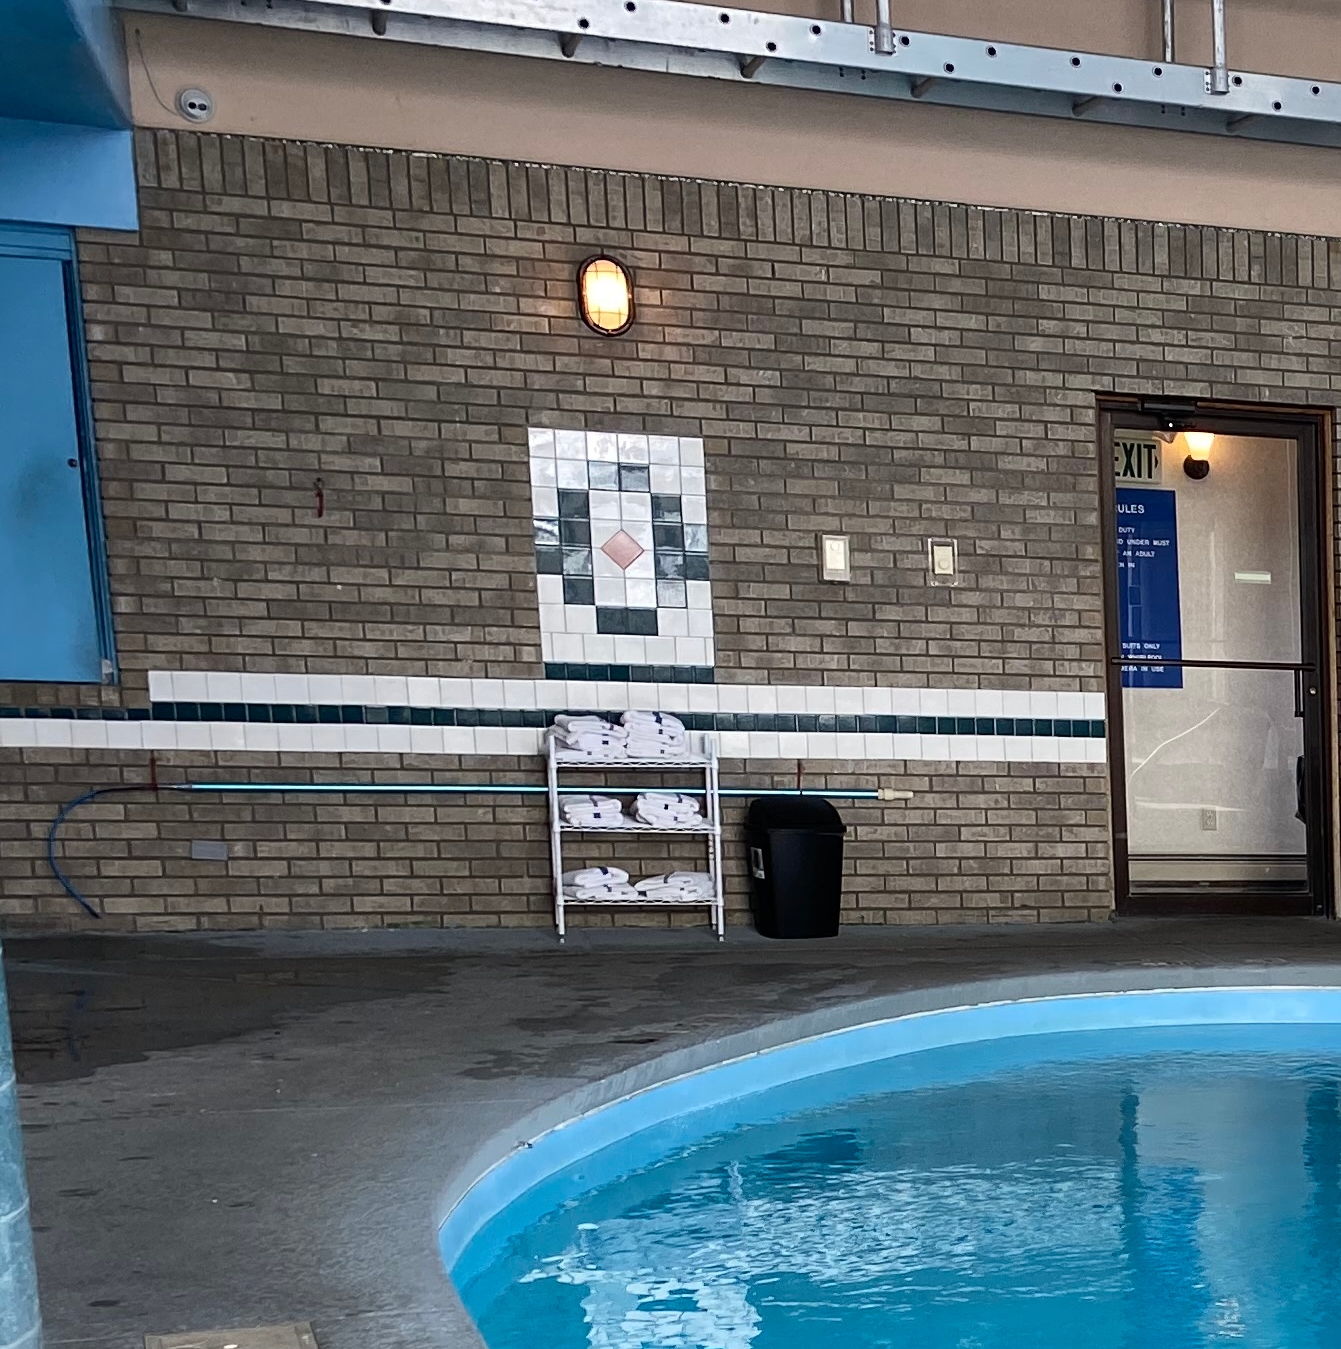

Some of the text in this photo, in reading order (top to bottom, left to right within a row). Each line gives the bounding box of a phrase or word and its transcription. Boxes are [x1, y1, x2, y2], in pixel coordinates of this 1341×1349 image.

[1116, 503, 1145, 514] ULES
[1118, 526, 1135, 534] DUTY
[1152, 539, 1170, 547] MUST
